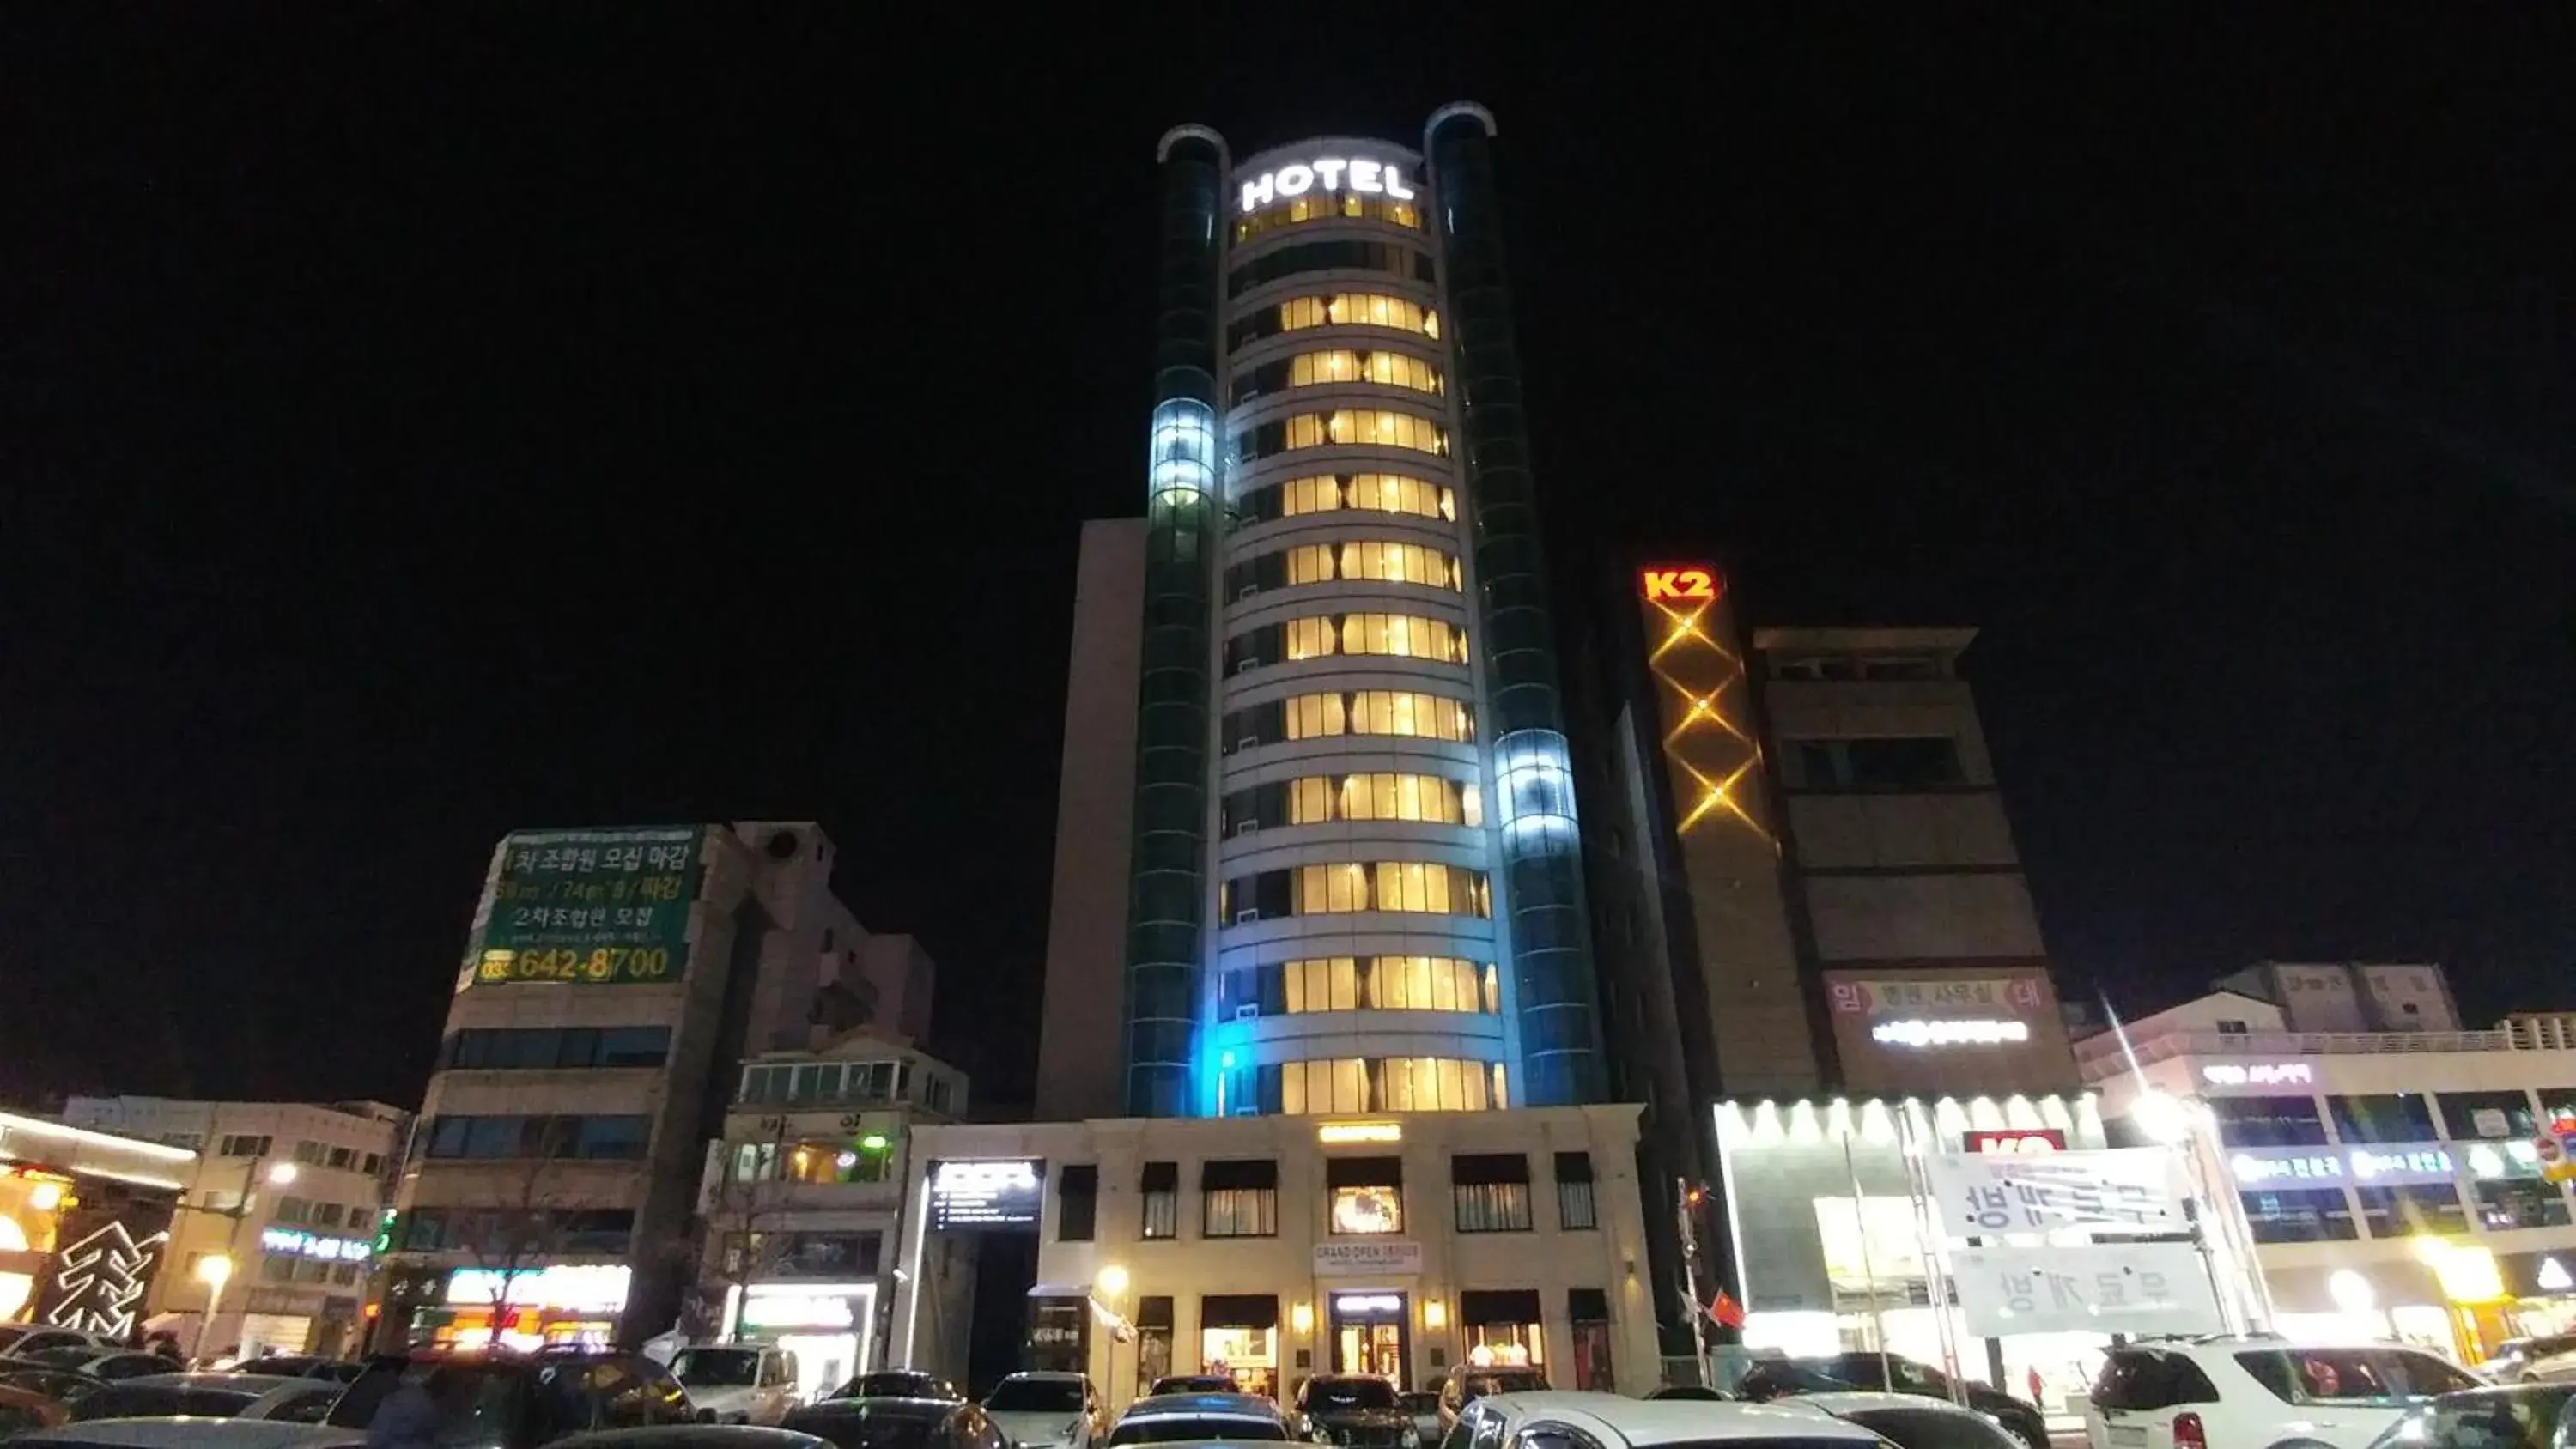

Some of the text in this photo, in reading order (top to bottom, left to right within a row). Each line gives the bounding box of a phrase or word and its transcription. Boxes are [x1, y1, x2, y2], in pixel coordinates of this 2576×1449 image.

[1242, 160, 1414, 211] HOTEL
[1644, 571, 1714, 597] K2
[648, 844, 690, 870] 마감
[519, 948, 669, 978] 642-8700
